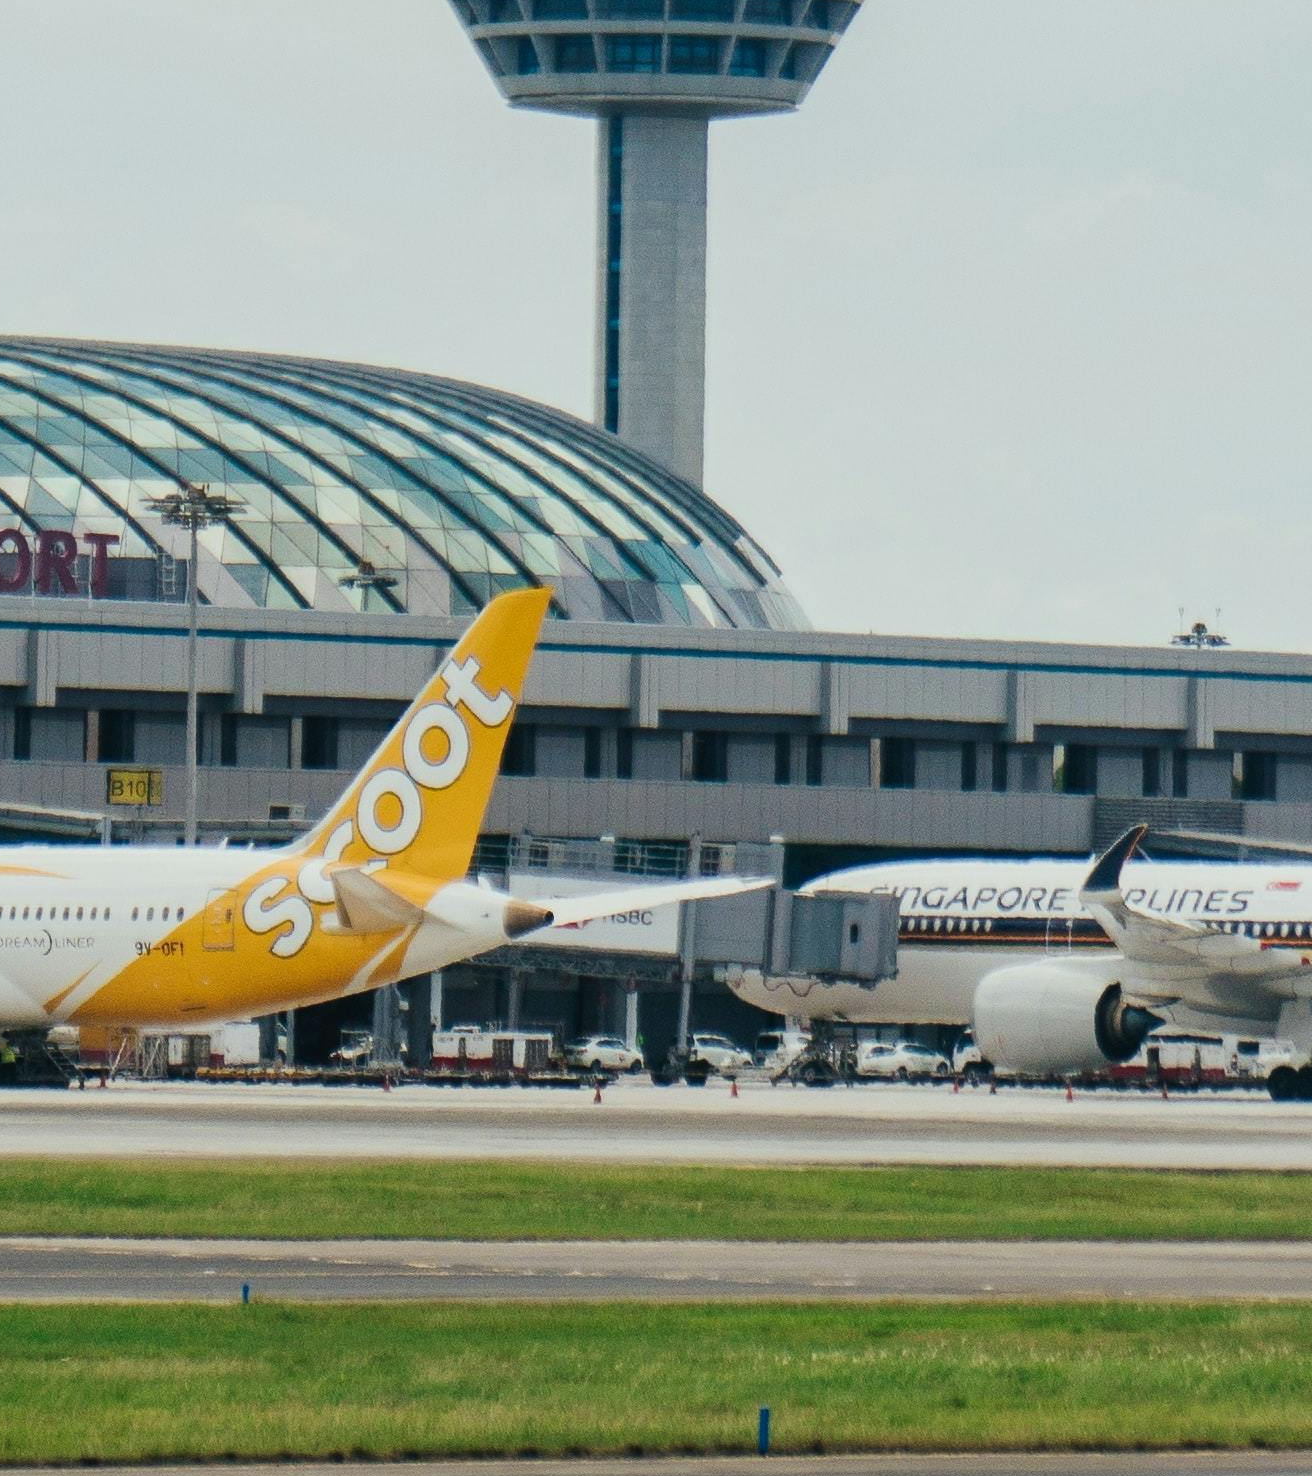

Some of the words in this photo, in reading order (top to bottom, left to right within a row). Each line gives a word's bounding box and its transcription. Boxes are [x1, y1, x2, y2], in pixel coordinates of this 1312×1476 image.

[111, 780, 147, 798] B10
[241, 654, 515, 959] scoot
[1080, 887, 1254, 913] RLINES
